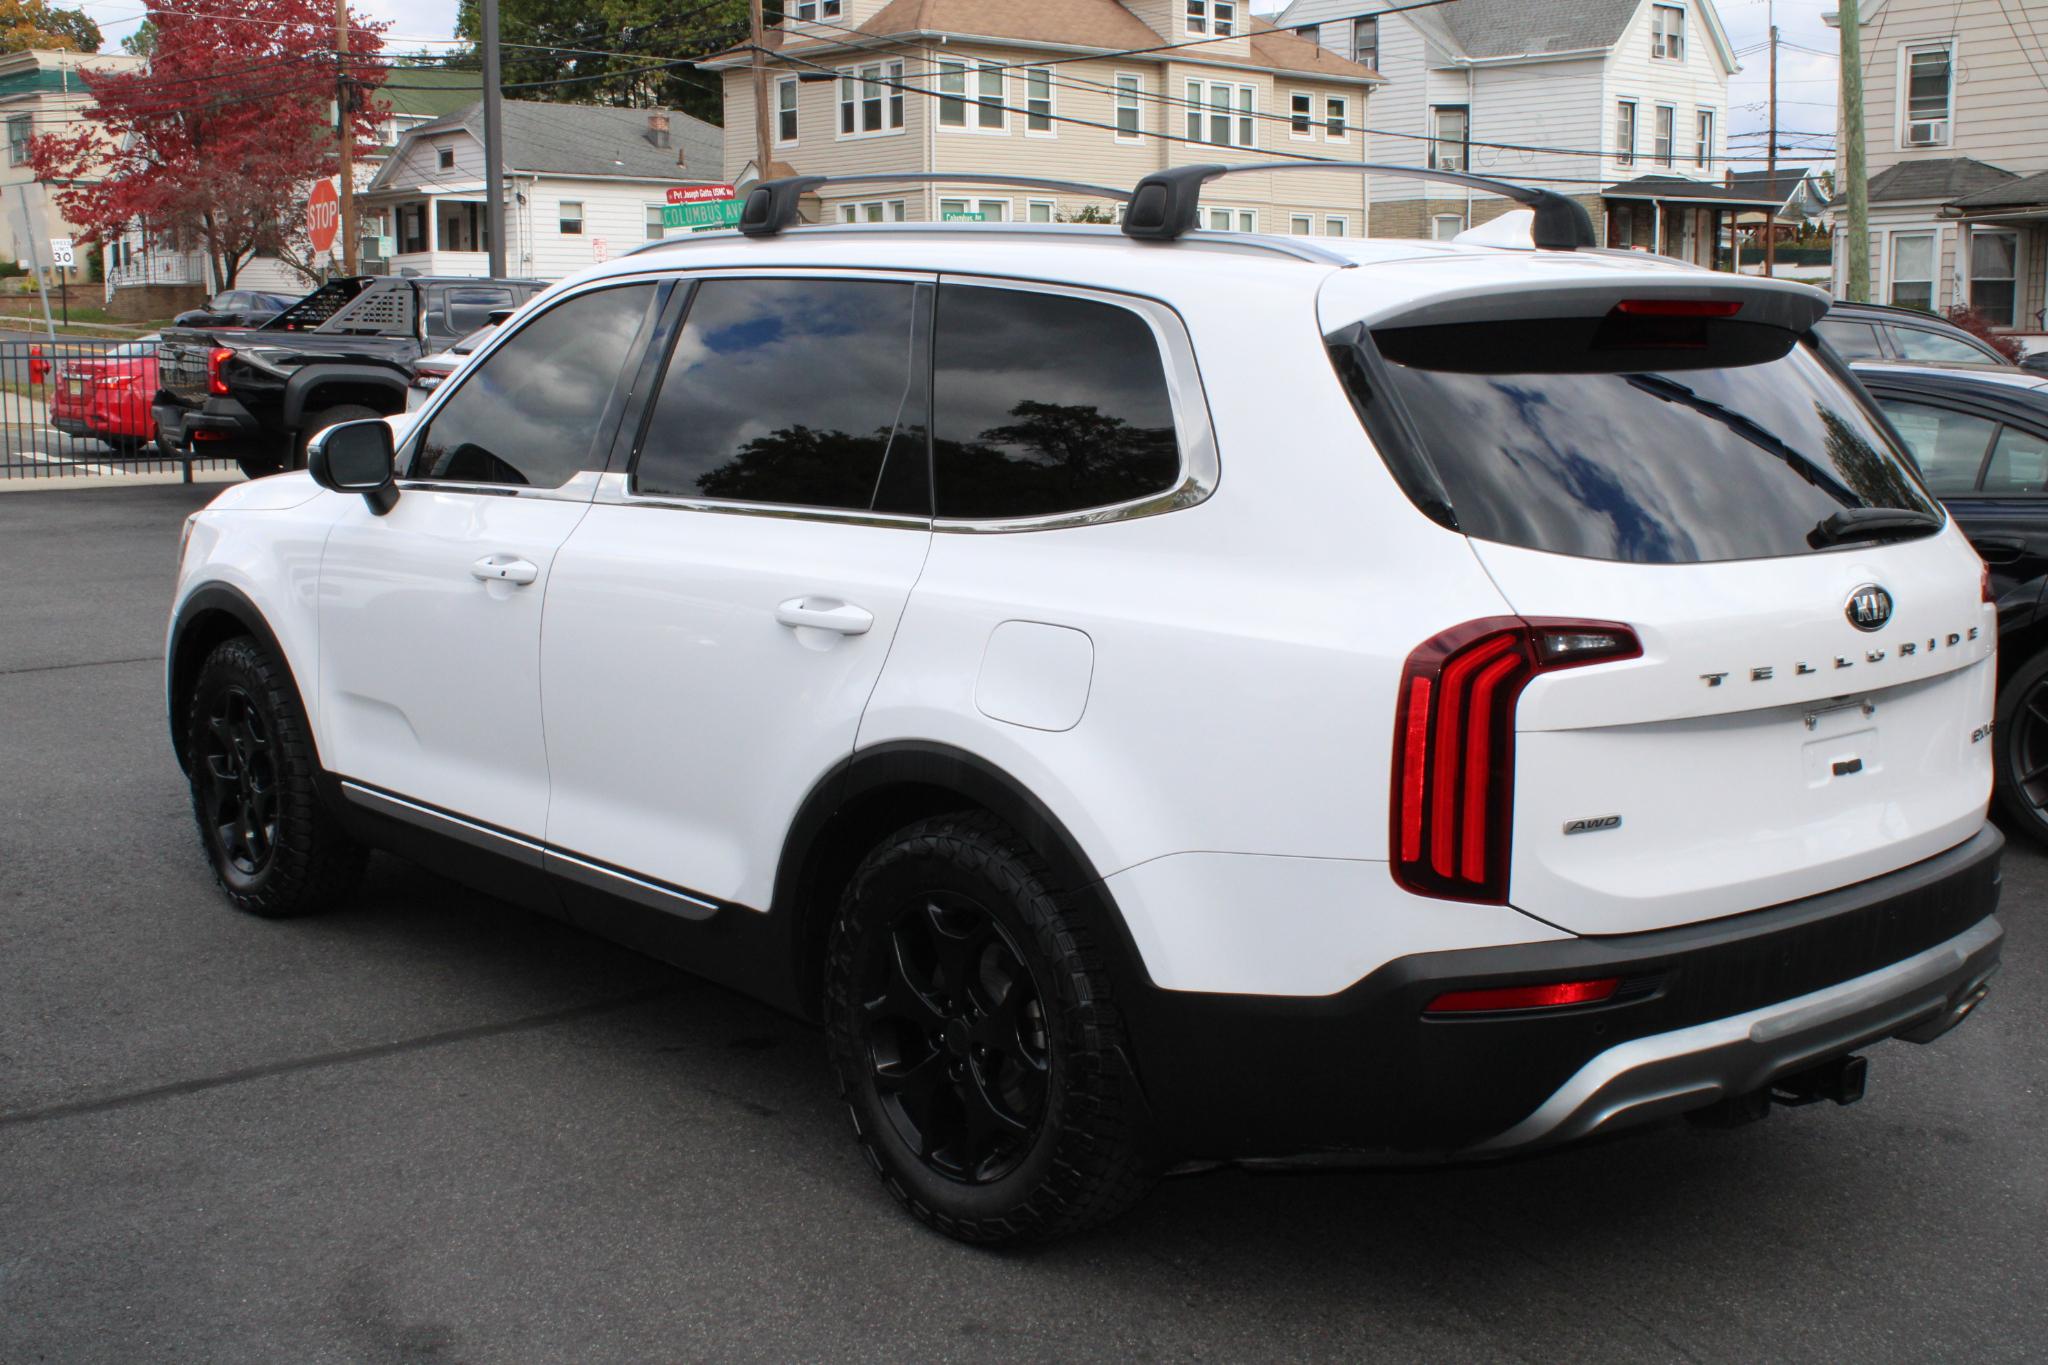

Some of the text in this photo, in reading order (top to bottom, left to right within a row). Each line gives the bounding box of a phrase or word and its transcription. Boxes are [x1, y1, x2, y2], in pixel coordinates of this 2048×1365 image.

[683, 189, 699, 200] Joseph
[713, 187, 725, 197] USMC
[310, 200, 337, 231] STOP
[664, 204, 722, 225] COLUMBUS
[54, 252, 71, 262] 30
[1854, 592, 1890, 622] KIA
[1699, 627, 1978, 688] TELLURIDE
[1569, 816, 1619, 831] AWD
